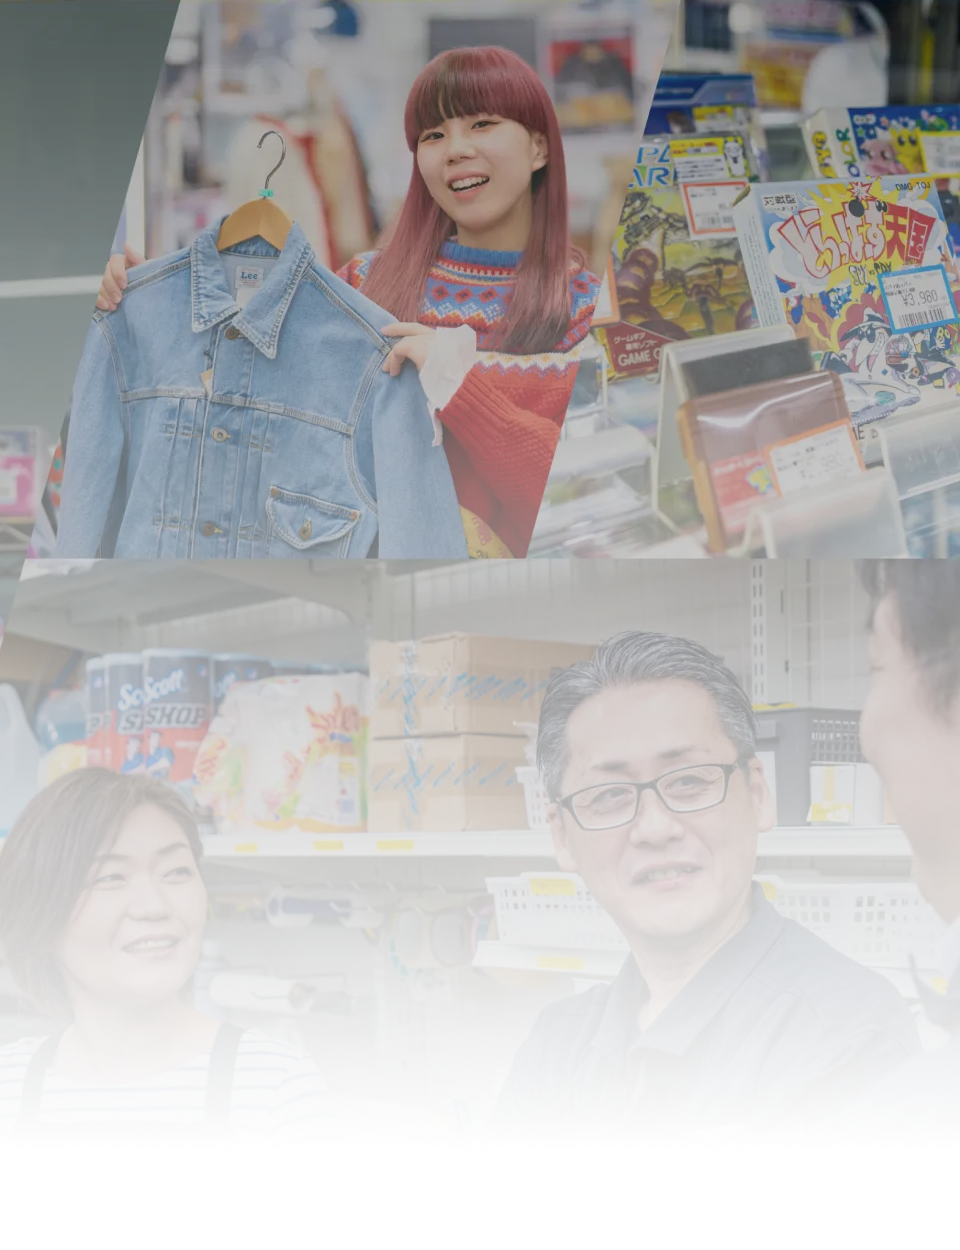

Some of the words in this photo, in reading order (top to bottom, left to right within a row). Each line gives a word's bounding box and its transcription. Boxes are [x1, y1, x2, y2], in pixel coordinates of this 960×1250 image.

[241, 271, 258, 279] Lee
[618, 350, 651, 367] GAME
[145, 706, 207, 726] SHOP
